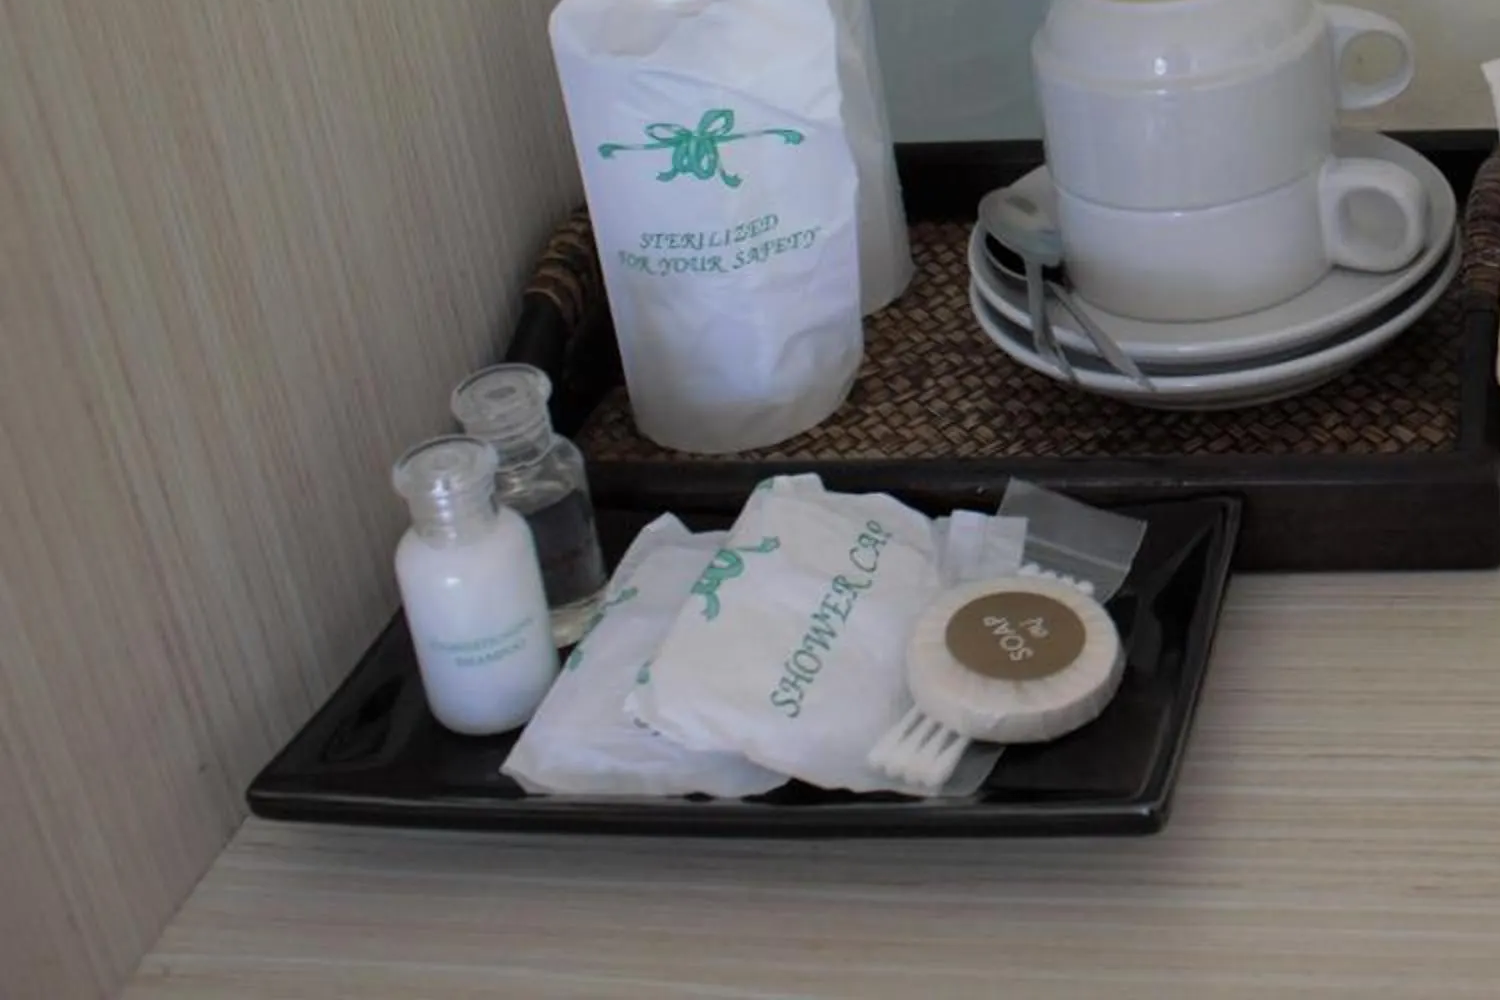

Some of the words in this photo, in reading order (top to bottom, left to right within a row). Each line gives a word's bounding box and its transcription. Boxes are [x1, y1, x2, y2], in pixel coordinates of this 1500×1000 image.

[639, 213, 779, 251] STERILIZED
[658, 255, 730, 277] YOUR
[731, 225, 823, 270] SAFETY
[769, 573, 873, 720] SHOWER
[983, 615, 1035, 661] SOAP
